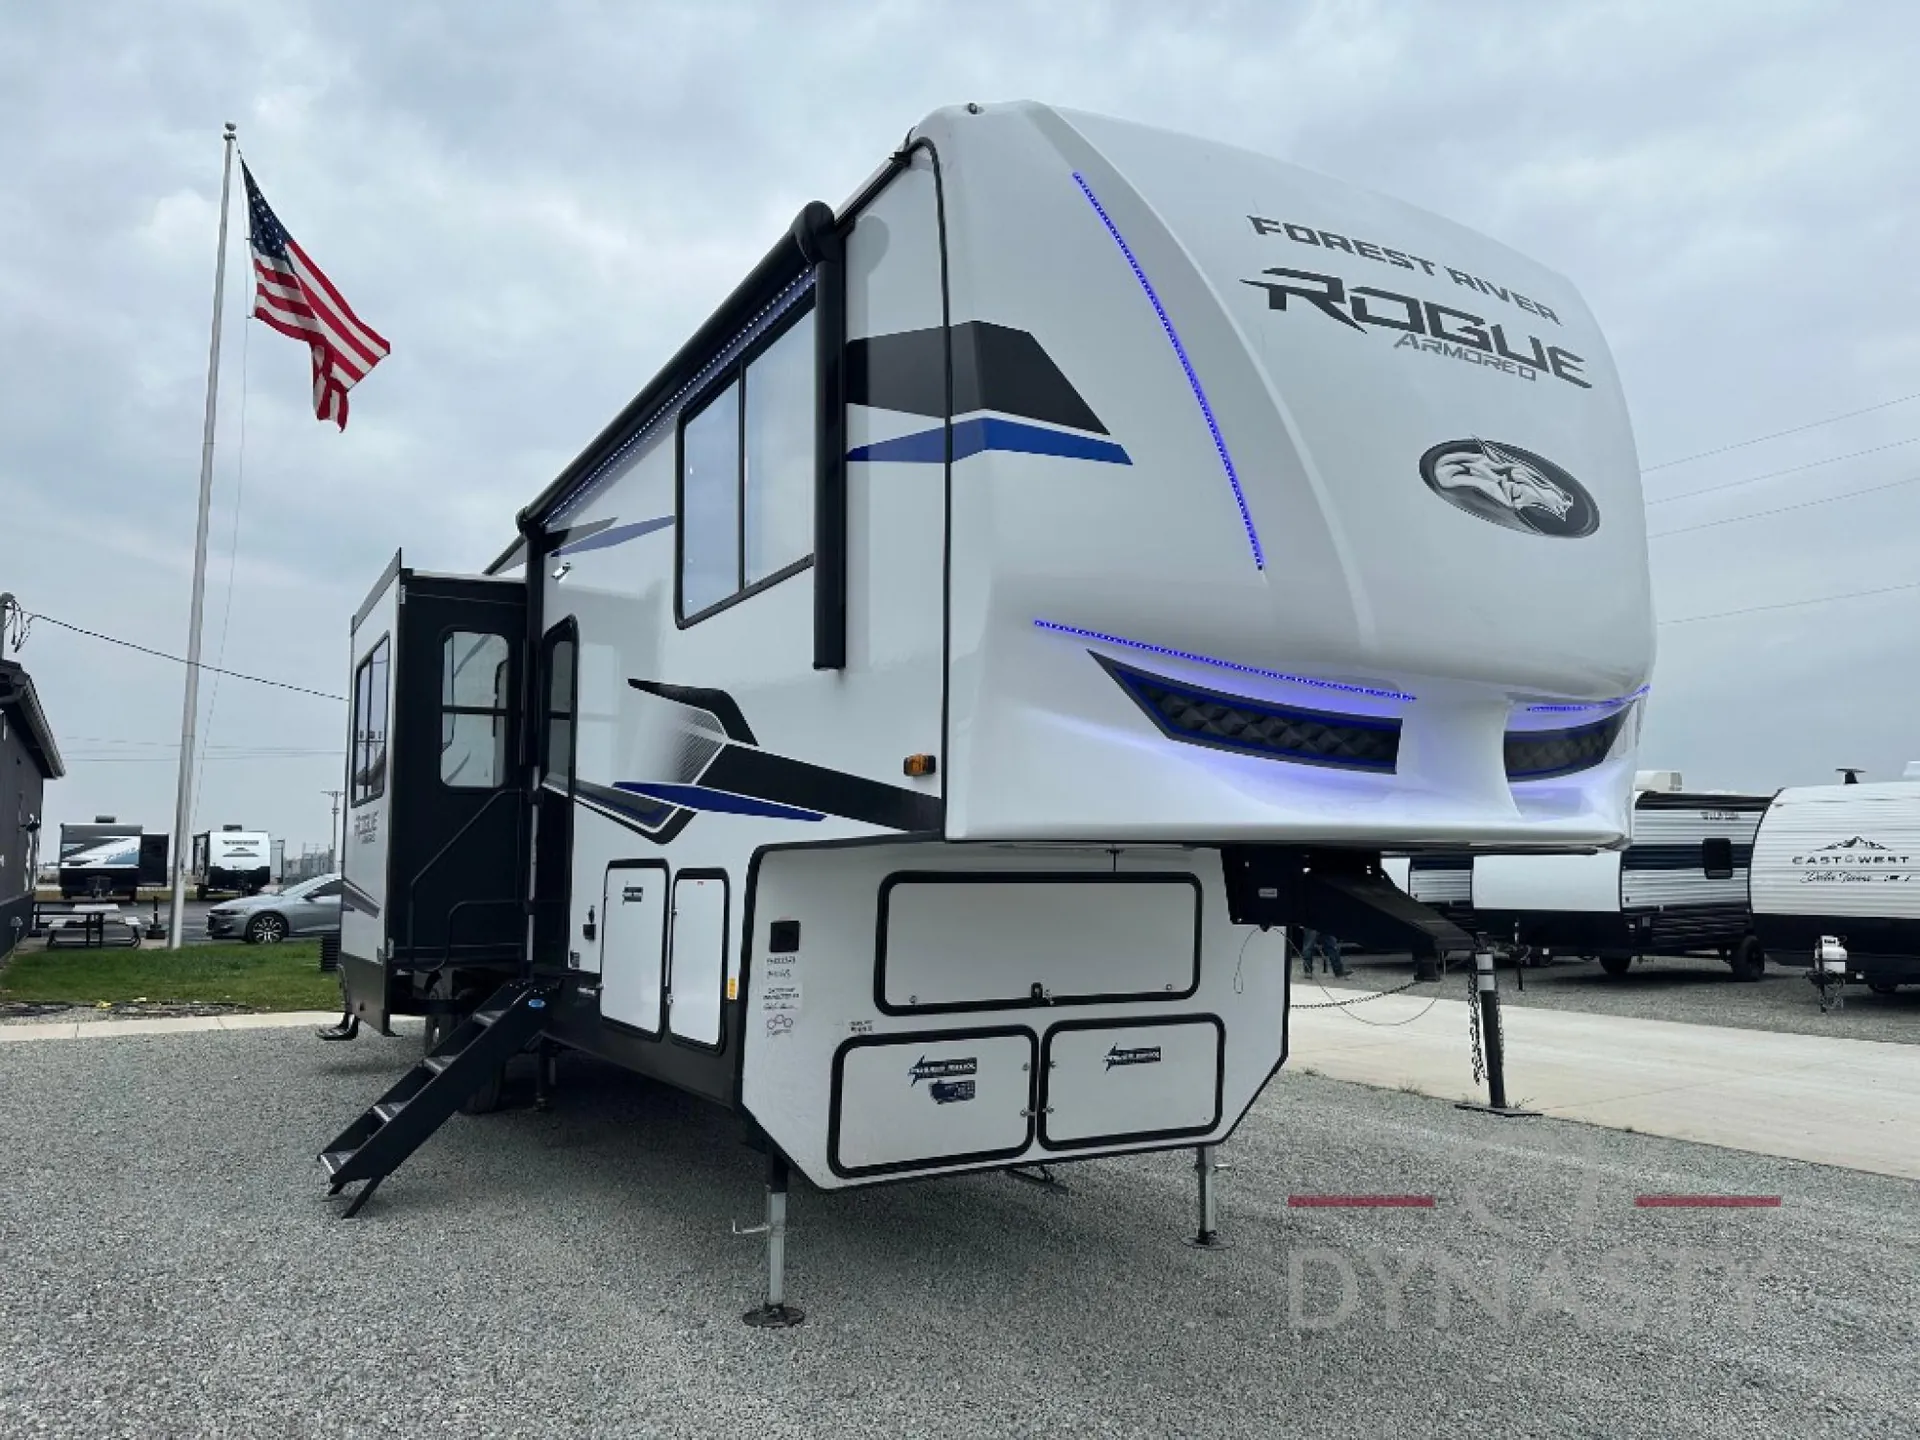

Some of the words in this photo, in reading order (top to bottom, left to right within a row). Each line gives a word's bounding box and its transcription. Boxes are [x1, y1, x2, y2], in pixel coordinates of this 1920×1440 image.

[1247, 215, 1436, 276] FOREST
[1444, 265, 1562, 326] RIVER
[1239, 267, 1593, 389] ROGUE
[1393, 333, 1537, 381] ARMORED
[1858, 856, 1910, 864] WEST
